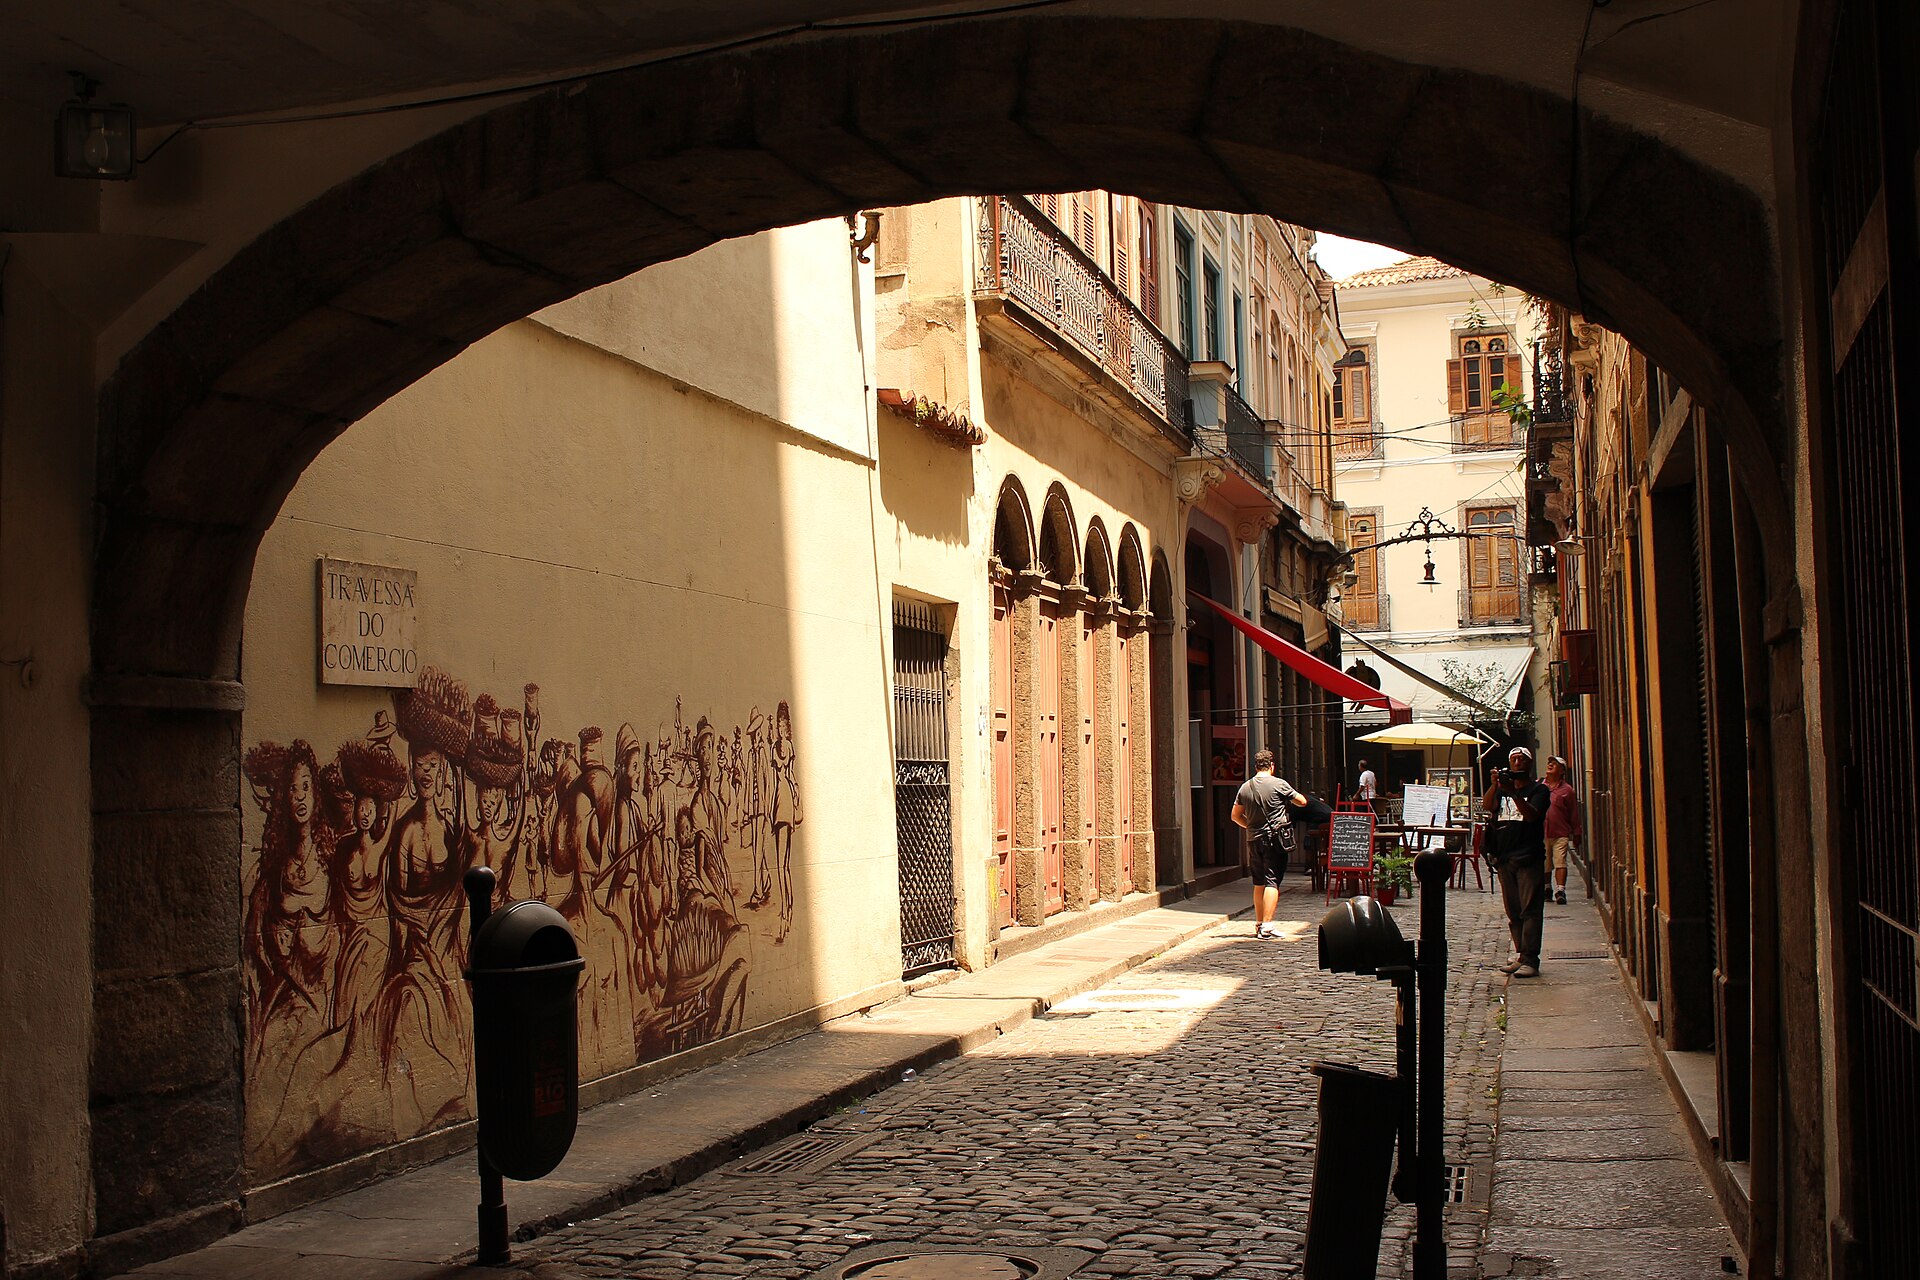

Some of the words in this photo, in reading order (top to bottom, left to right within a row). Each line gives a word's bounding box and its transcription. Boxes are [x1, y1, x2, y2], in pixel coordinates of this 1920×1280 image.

[327, 572, 414, 608] TRAVESSA
[359, 611, 384, 638] DO
[324, 643, 418, 674] COMERCIO
[535, 1081, 565, 1104] RIO
